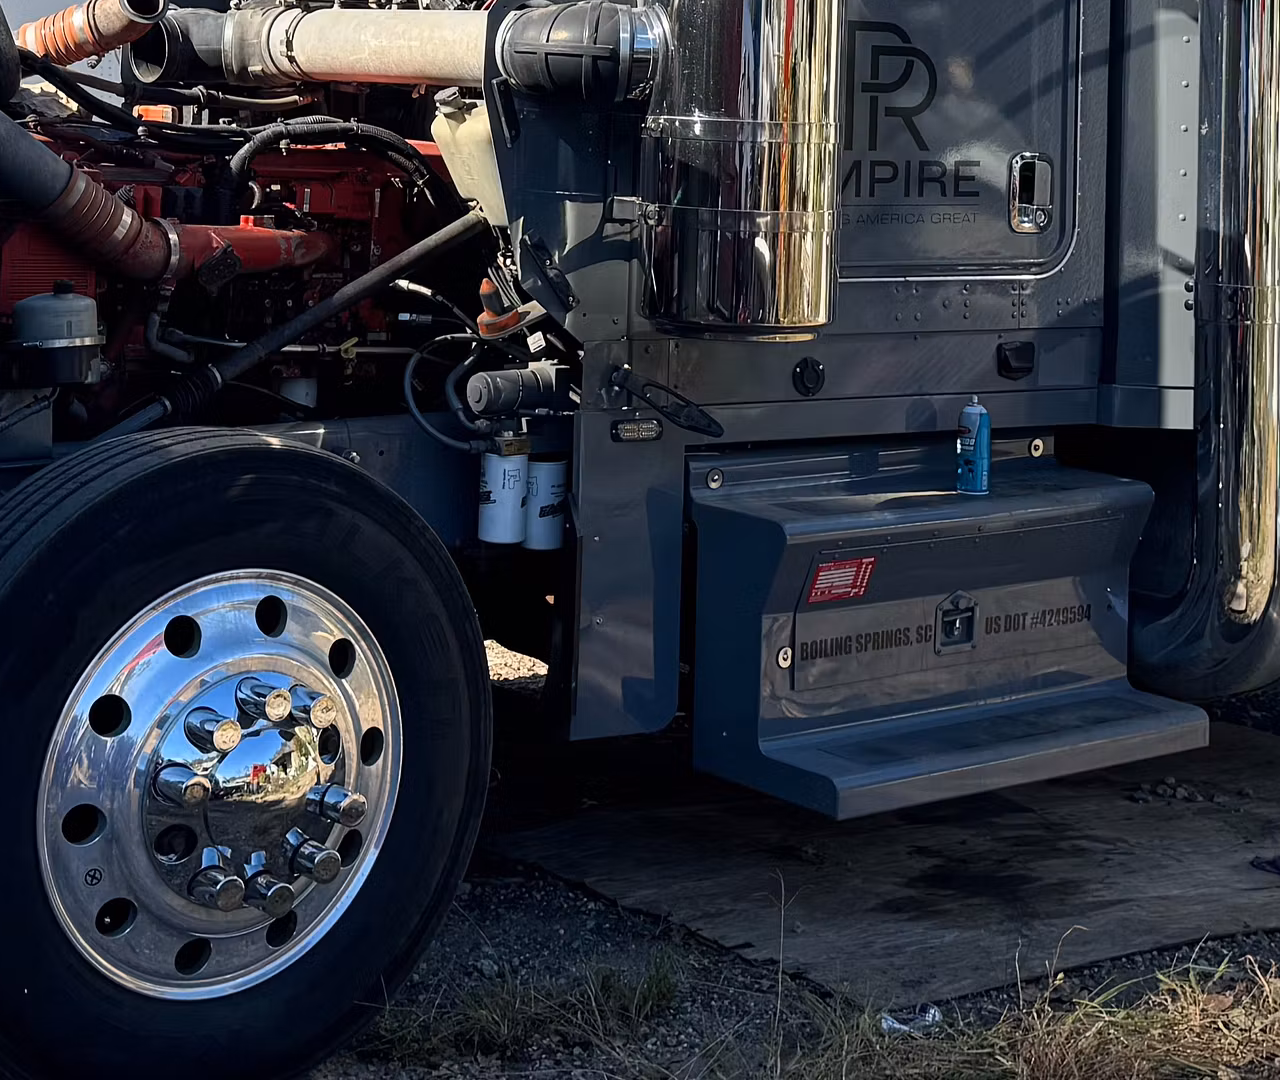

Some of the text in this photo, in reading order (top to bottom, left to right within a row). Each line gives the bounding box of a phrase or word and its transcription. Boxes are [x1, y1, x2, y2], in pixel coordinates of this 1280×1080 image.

[856, 213, 925, 224] AMERICA
[930, 212, 980, 224] GREAT
[985, 615, 1001, 635] US
[1003, 612, 1028, 633] DOT
[800, 624, 933, 661] BOILING SPRINGS, SC
